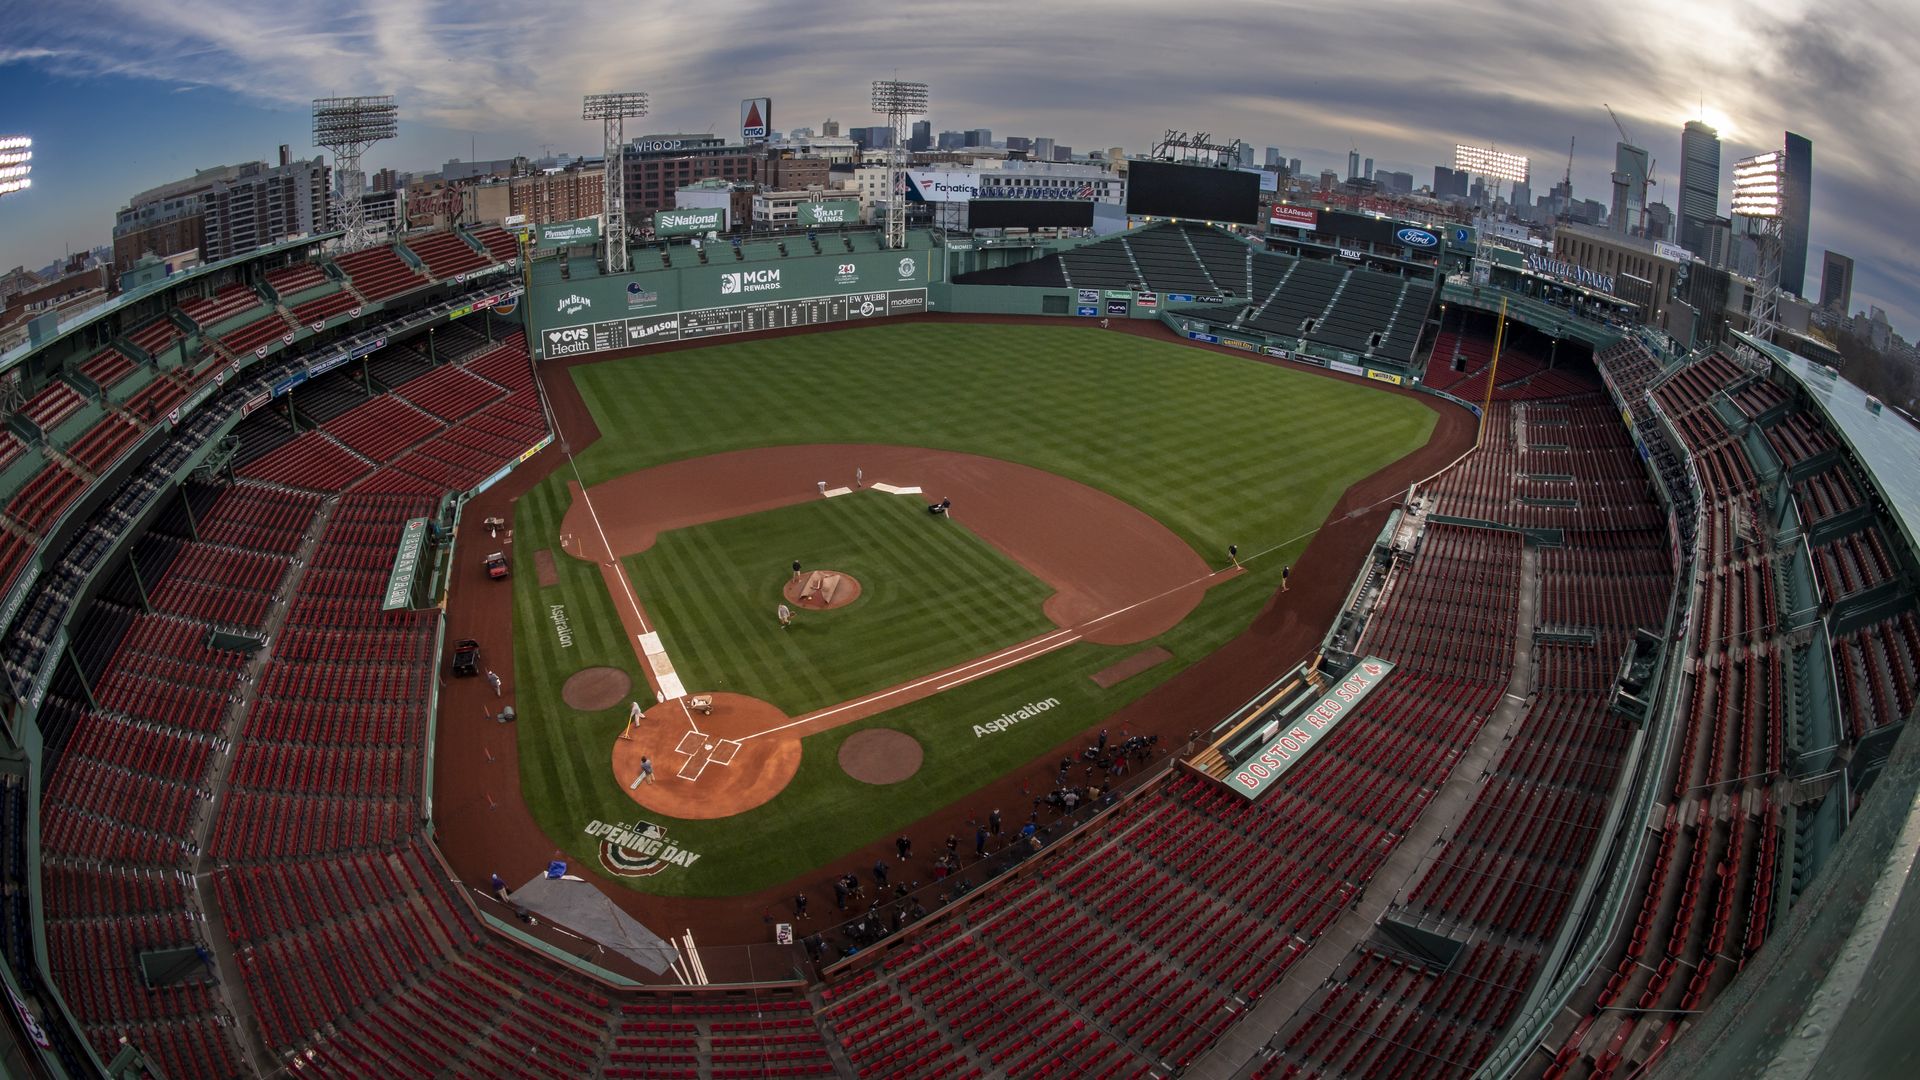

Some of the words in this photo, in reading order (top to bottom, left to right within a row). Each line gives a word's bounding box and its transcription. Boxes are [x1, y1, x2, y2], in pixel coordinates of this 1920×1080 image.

[743, 127, 764, 137] CITGO
[634, 140, 682, 152] WHOOP
[1152, 129, 1189, 158] John
[1187, 131, 1240, 159] Hancock
[935, 182, 974, 193] Fanatics
[971, 187, 1001, 198] BANK
[816, 209, 844, 218] DRAFT
[817, 214, 844, 223] KINGS
[1275, 206, 1313, 218] CLEAResult
[674, 213, 718, 226] National
[544, 228, 575, 239] Plymouth
[575, 226, 592, 235] Rock
[1405, 230, 1429, 244] Ford
[1339, 248, 1361, 258] TRULY
[743, 269, 780, 284] MGM
[1527, 253, 1571, 280] SAMUEL
[1571, 265, 1614, 292] ADAMS
[743, 282, 781, 292] REWARDS
[557, 297, 570, 312] JIM
[571, 294, 591, 307] BEAM
[864, 293, 886, 301] WEBB
[890, 297, 923, 306] moderna
[562, 328, 589, 341] CVS
[552, 341, 590, 355] Health
[390, 574, 411, 606] PARK
[550, 604, 573, 648] Aspiration
[972, 697, 1061, 738] Aspiration
[1236, 727, 1311, 790] BOSTON
[1305, 698, 1342, 729] RED
[1336, 673, 1372, 703] SOX
[584, 819, 664, 857] OPENING
[660, 844, 701, 868] DAY
